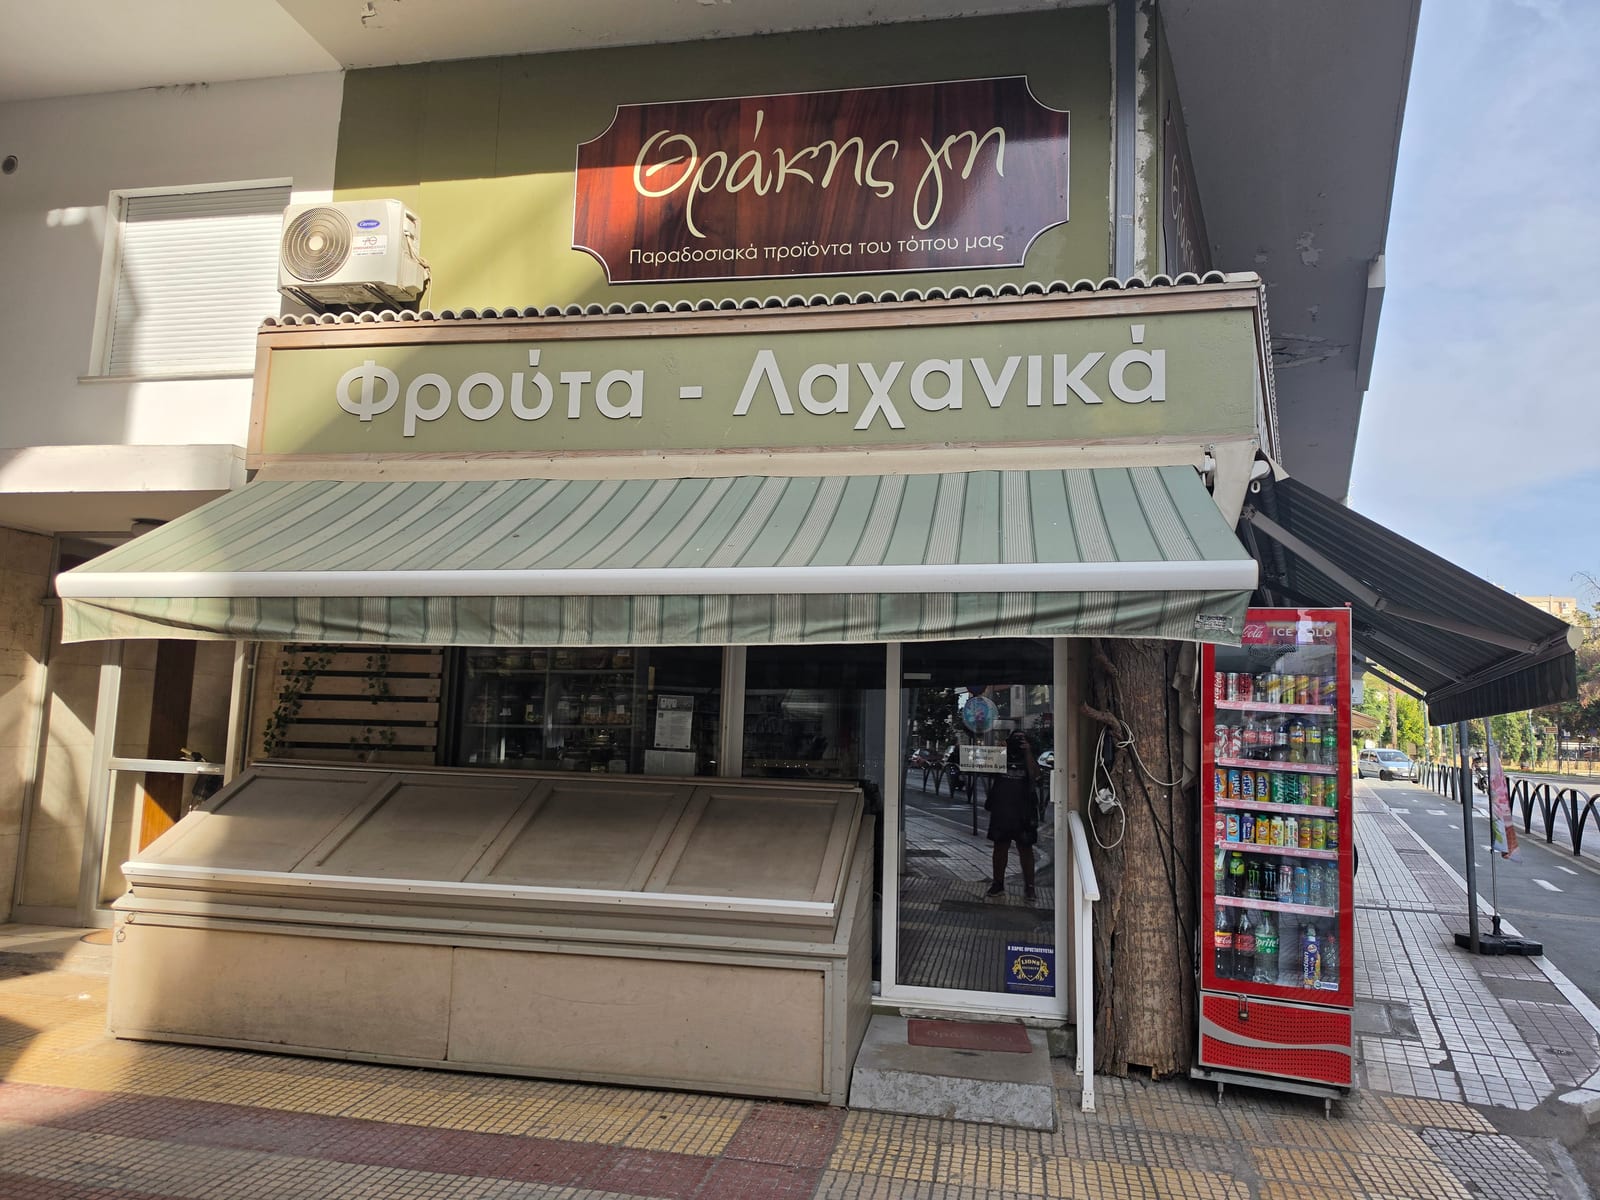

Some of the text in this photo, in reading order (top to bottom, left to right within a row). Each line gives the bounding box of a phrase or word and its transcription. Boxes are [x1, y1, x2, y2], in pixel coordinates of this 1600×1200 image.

[633, 110, 1006, 238] Θράκης γη
[629, 234, 1005, 266] Παραδοσιακά προϊόντα του τόπου μας
[336, 324, 1166, 437] Φρούτα - Λαχανικά
[1272, 628, 1294, 637] ICE
